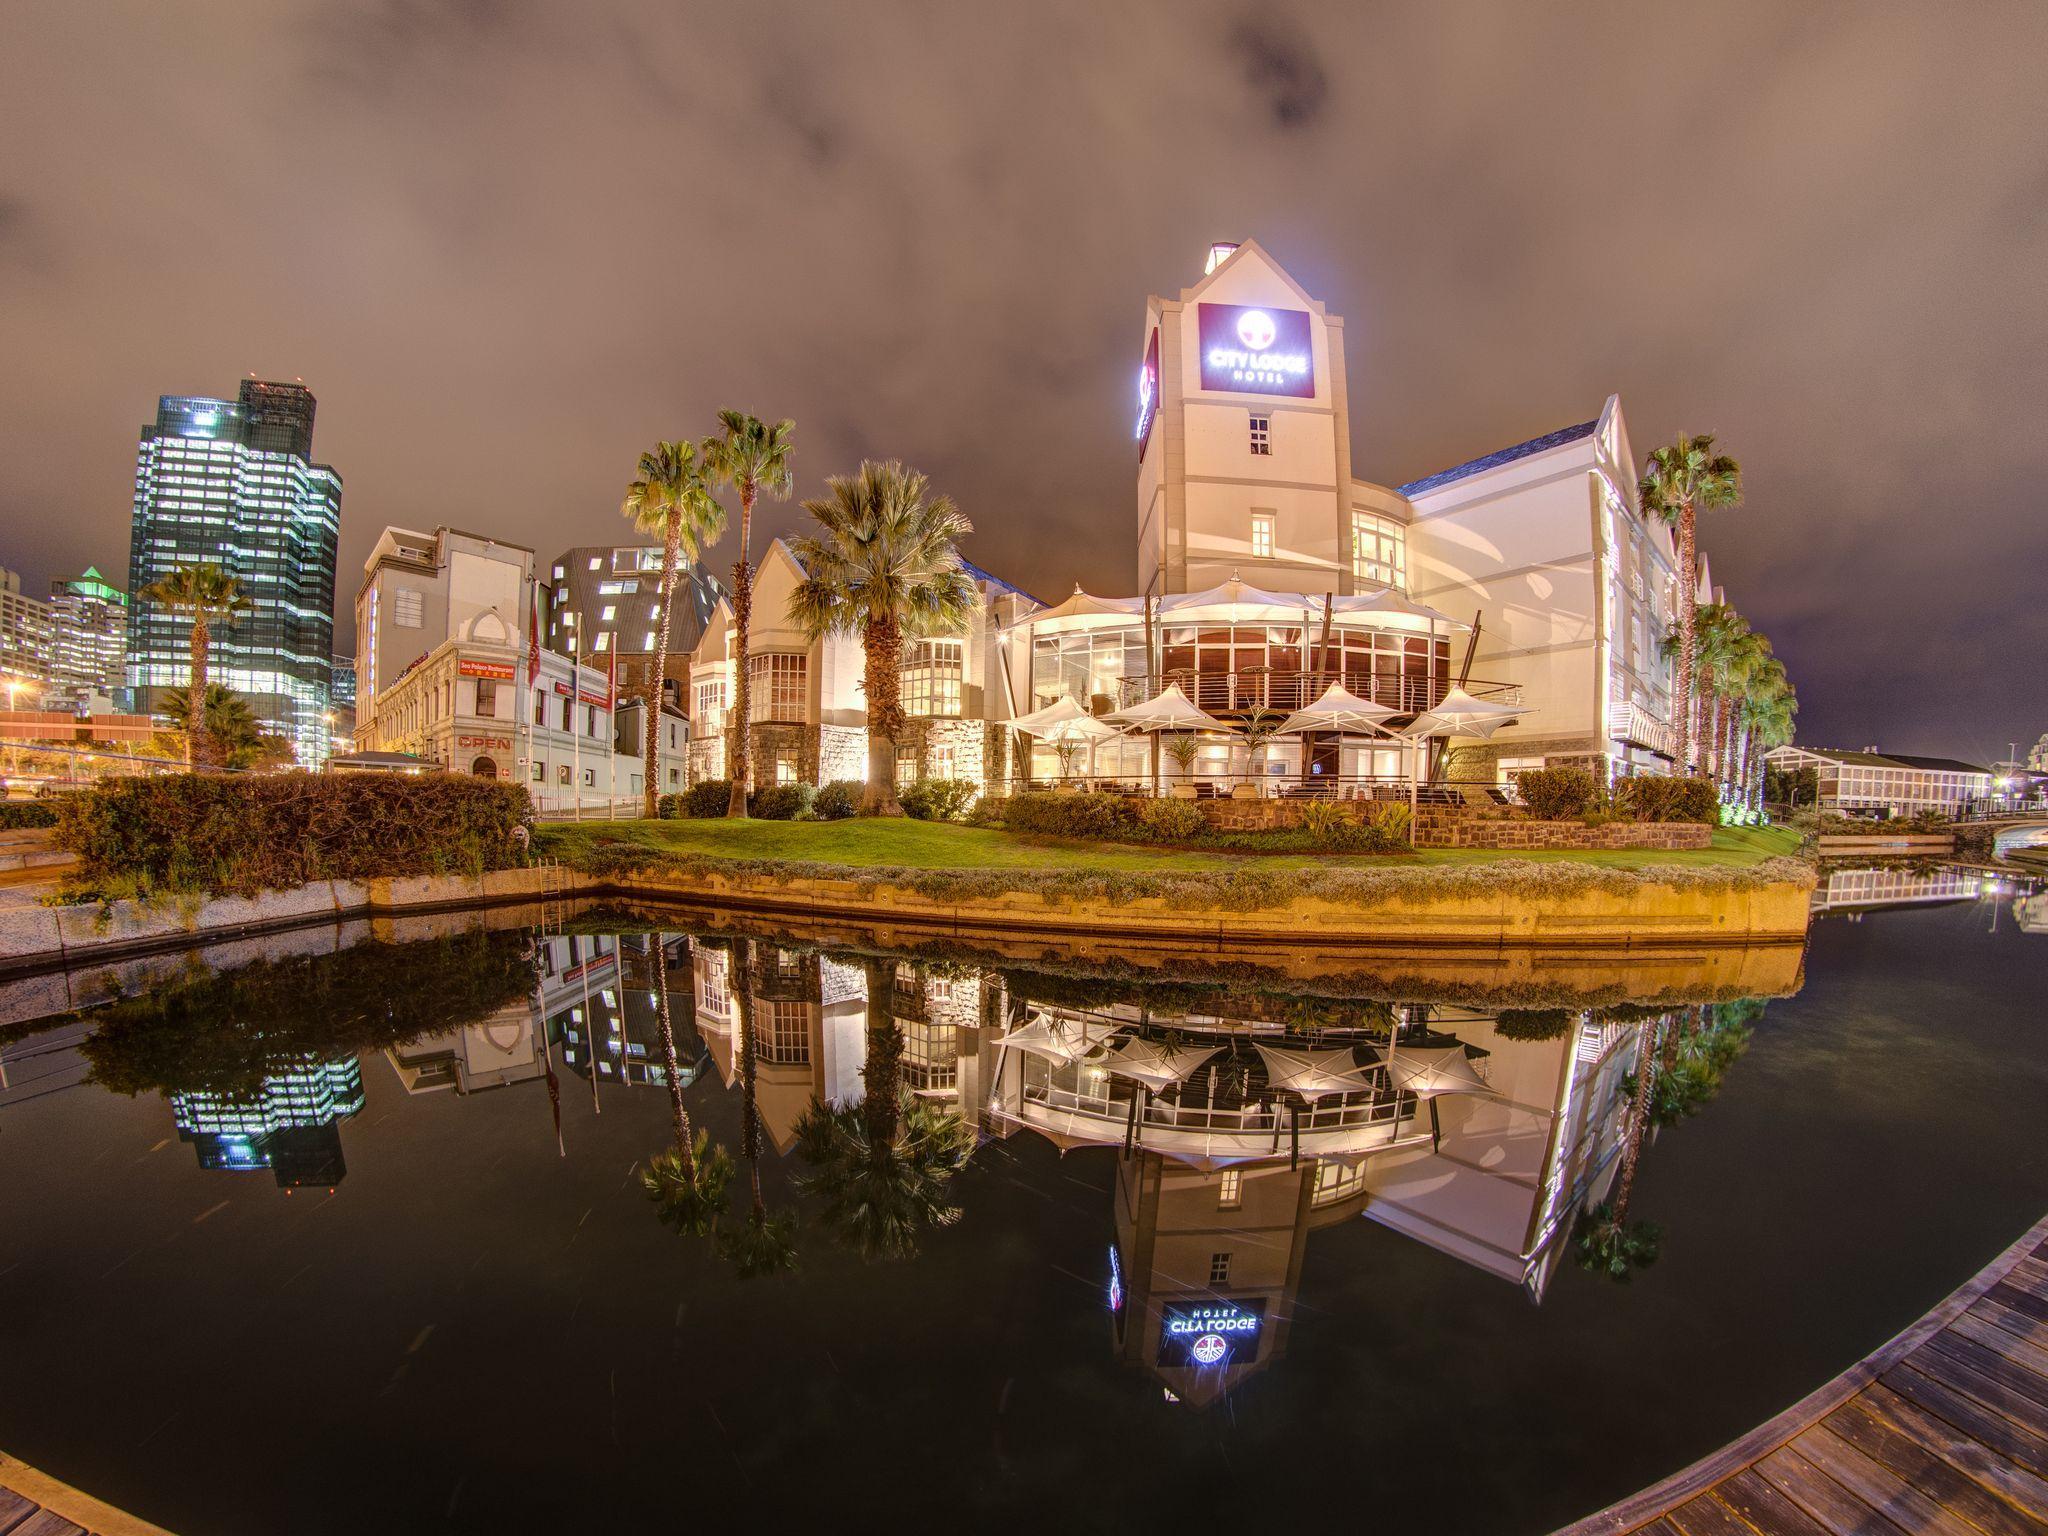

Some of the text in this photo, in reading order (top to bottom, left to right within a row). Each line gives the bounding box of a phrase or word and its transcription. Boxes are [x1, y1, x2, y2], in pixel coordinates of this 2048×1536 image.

[1208, 349, 1307, 373] CITY LODGE
[1233, 370, 1284, 384] HOTEL
[459, 736, 511, 750] OPEN
